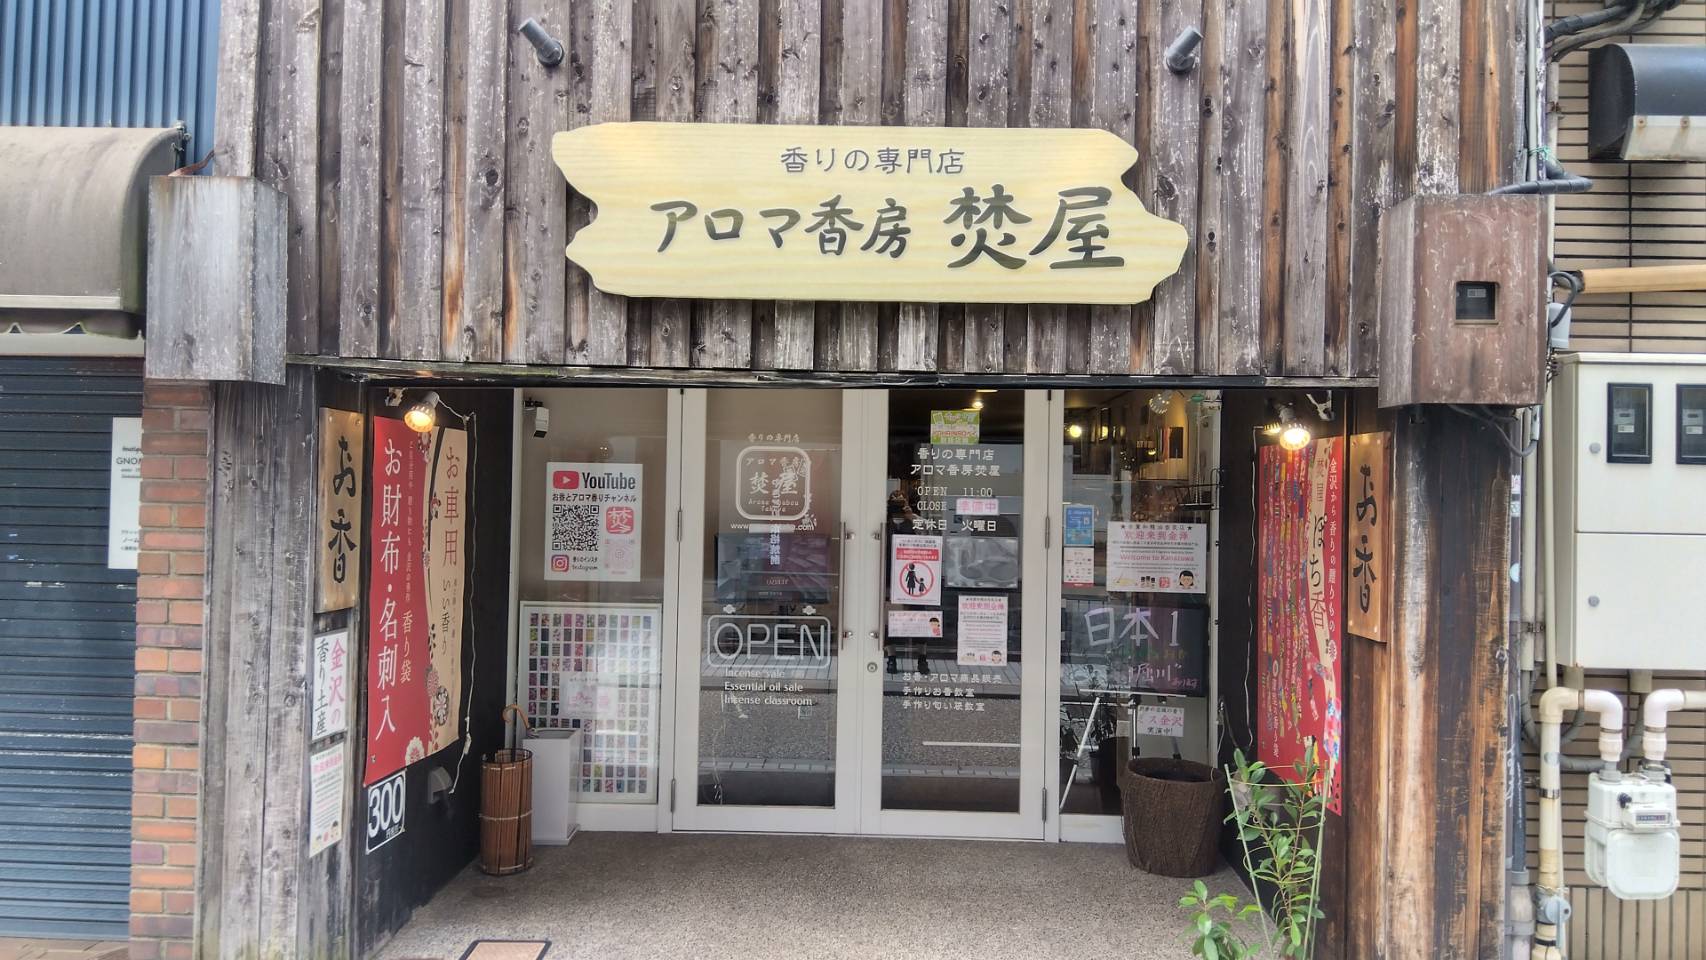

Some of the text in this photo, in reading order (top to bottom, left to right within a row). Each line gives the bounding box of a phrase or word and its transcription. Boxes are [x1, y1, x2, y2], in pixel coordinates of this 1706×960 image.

[780, 147, 966, 175] 香りの専門店
[650, 185, 1126, 270] アロマ香房 焚屋
[918, 448, 994, 460] 香りの専門店
[582, 472, 636, 489] YouTube
[911, 464, 1000, 476] アロマ香房焚屋
[553, 493, 637, 502] お香とアロマ香りチャンネル
[917, 487, 992, 497] OPEN 11:00
[917, 501, 948, 511] CLOSE
[328, 435, 357, 584] お香
[444, 447, 460, 566] お車用
[912, 520, 997, 531] 定休日 火曜日
[1353, 464, 1377, 613] お香
[1309, 513, 1328, 628] ぽち香
[376, 438, 402, 740] お財布・名刺入
[400, 610, 413, 683] 香り袋
[714, 623, 825, 660] OPEN
[315, 638, 329, 735] 香り土産
[329, 638, 346, 725] 金沢の
[724, 681, 804, 692] Essential oil sale
[725, 669, 761, 678] Incense
[724, 694, 812, 705] Incense classroom
[903, 686, 975, 697] 手作りお香教室
[368, 776, 404, 838] 300
